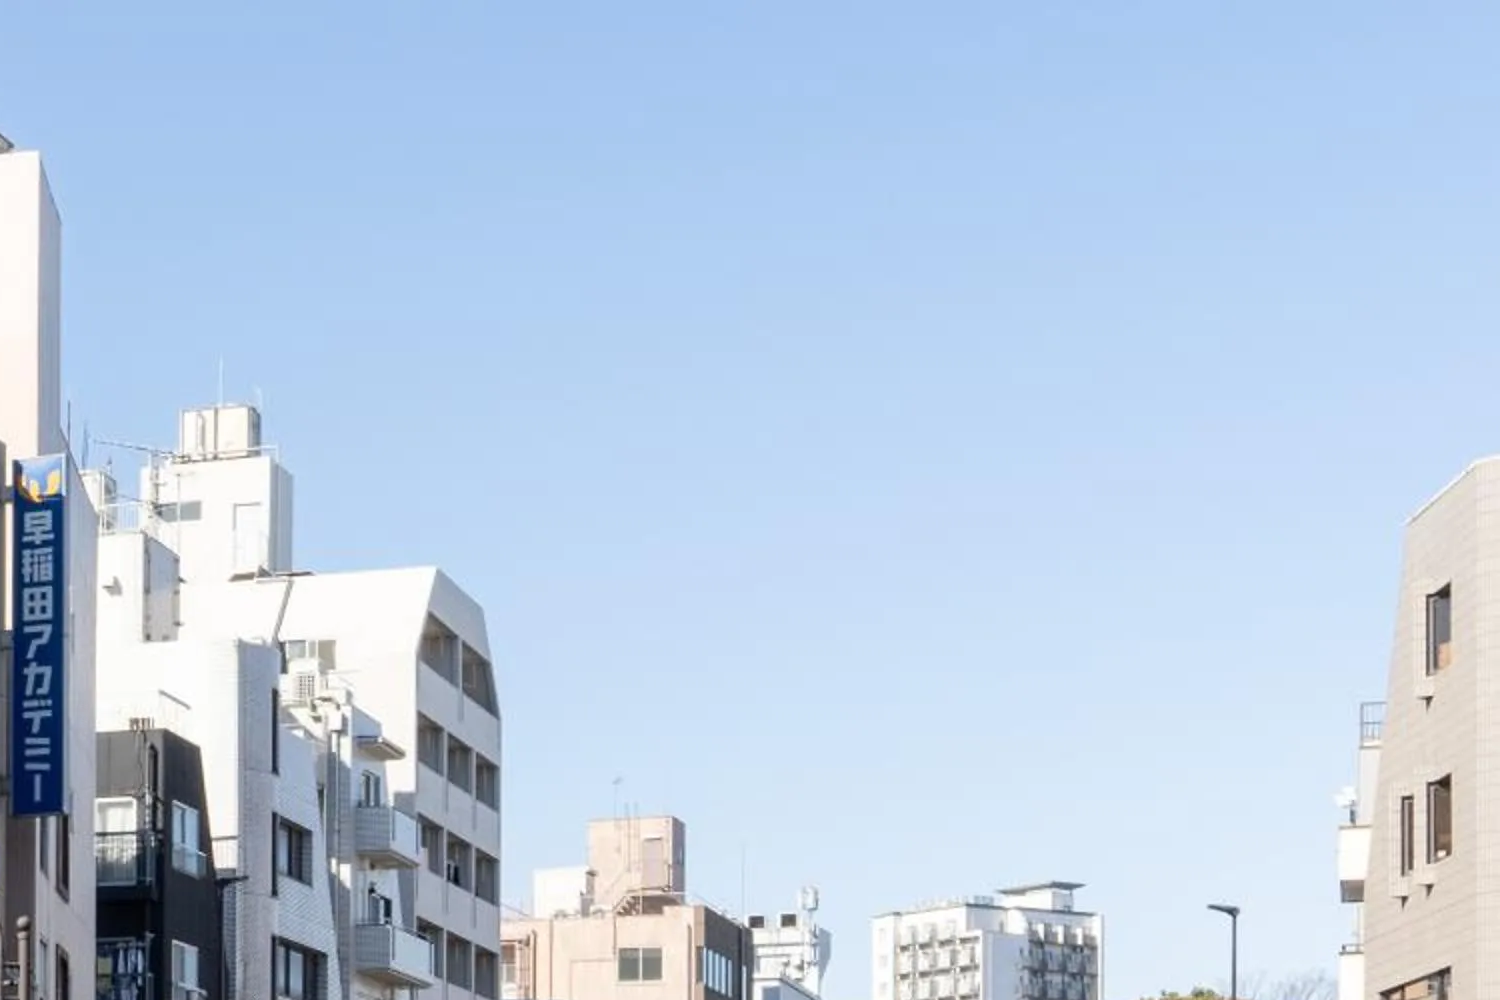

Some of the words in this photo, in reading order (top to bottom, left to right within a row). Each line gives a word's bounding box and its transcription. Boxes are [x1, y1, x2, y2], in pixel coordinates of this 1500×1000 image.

[22, 510, 55, 803] 早稲田アカデミー
